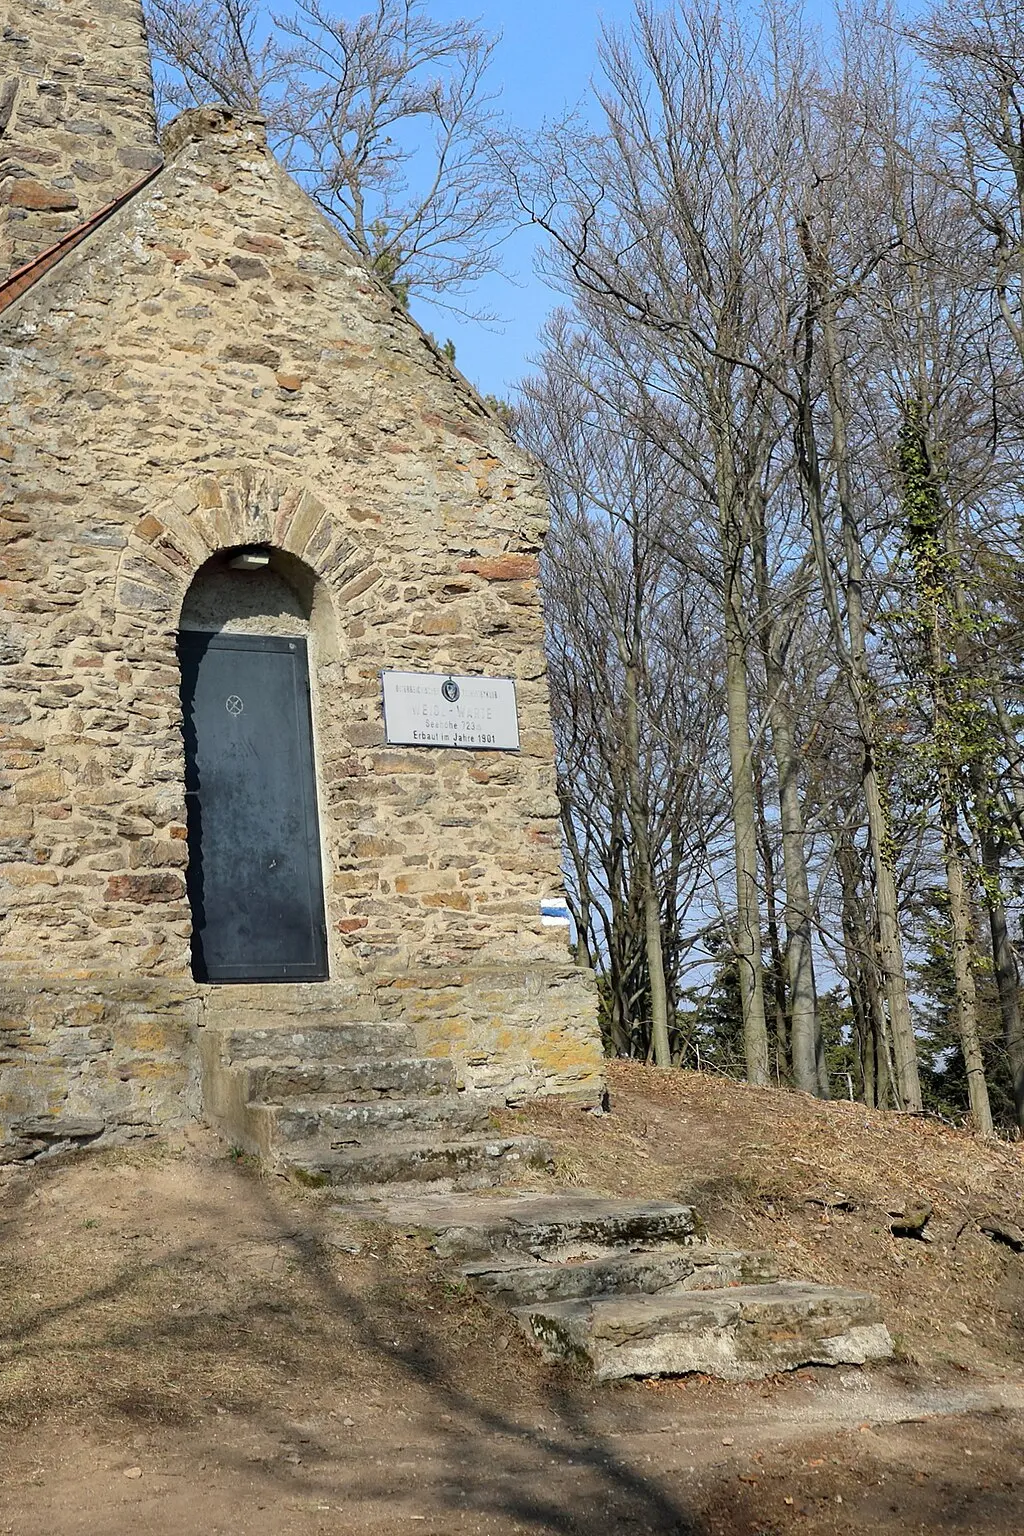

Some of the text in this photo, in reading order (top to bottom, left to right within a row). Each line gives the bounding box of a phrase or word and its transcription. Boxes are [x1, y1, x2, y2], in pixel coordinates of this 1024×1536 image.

[413, 730, 496, 744] Erbaut im Jahre 1901
